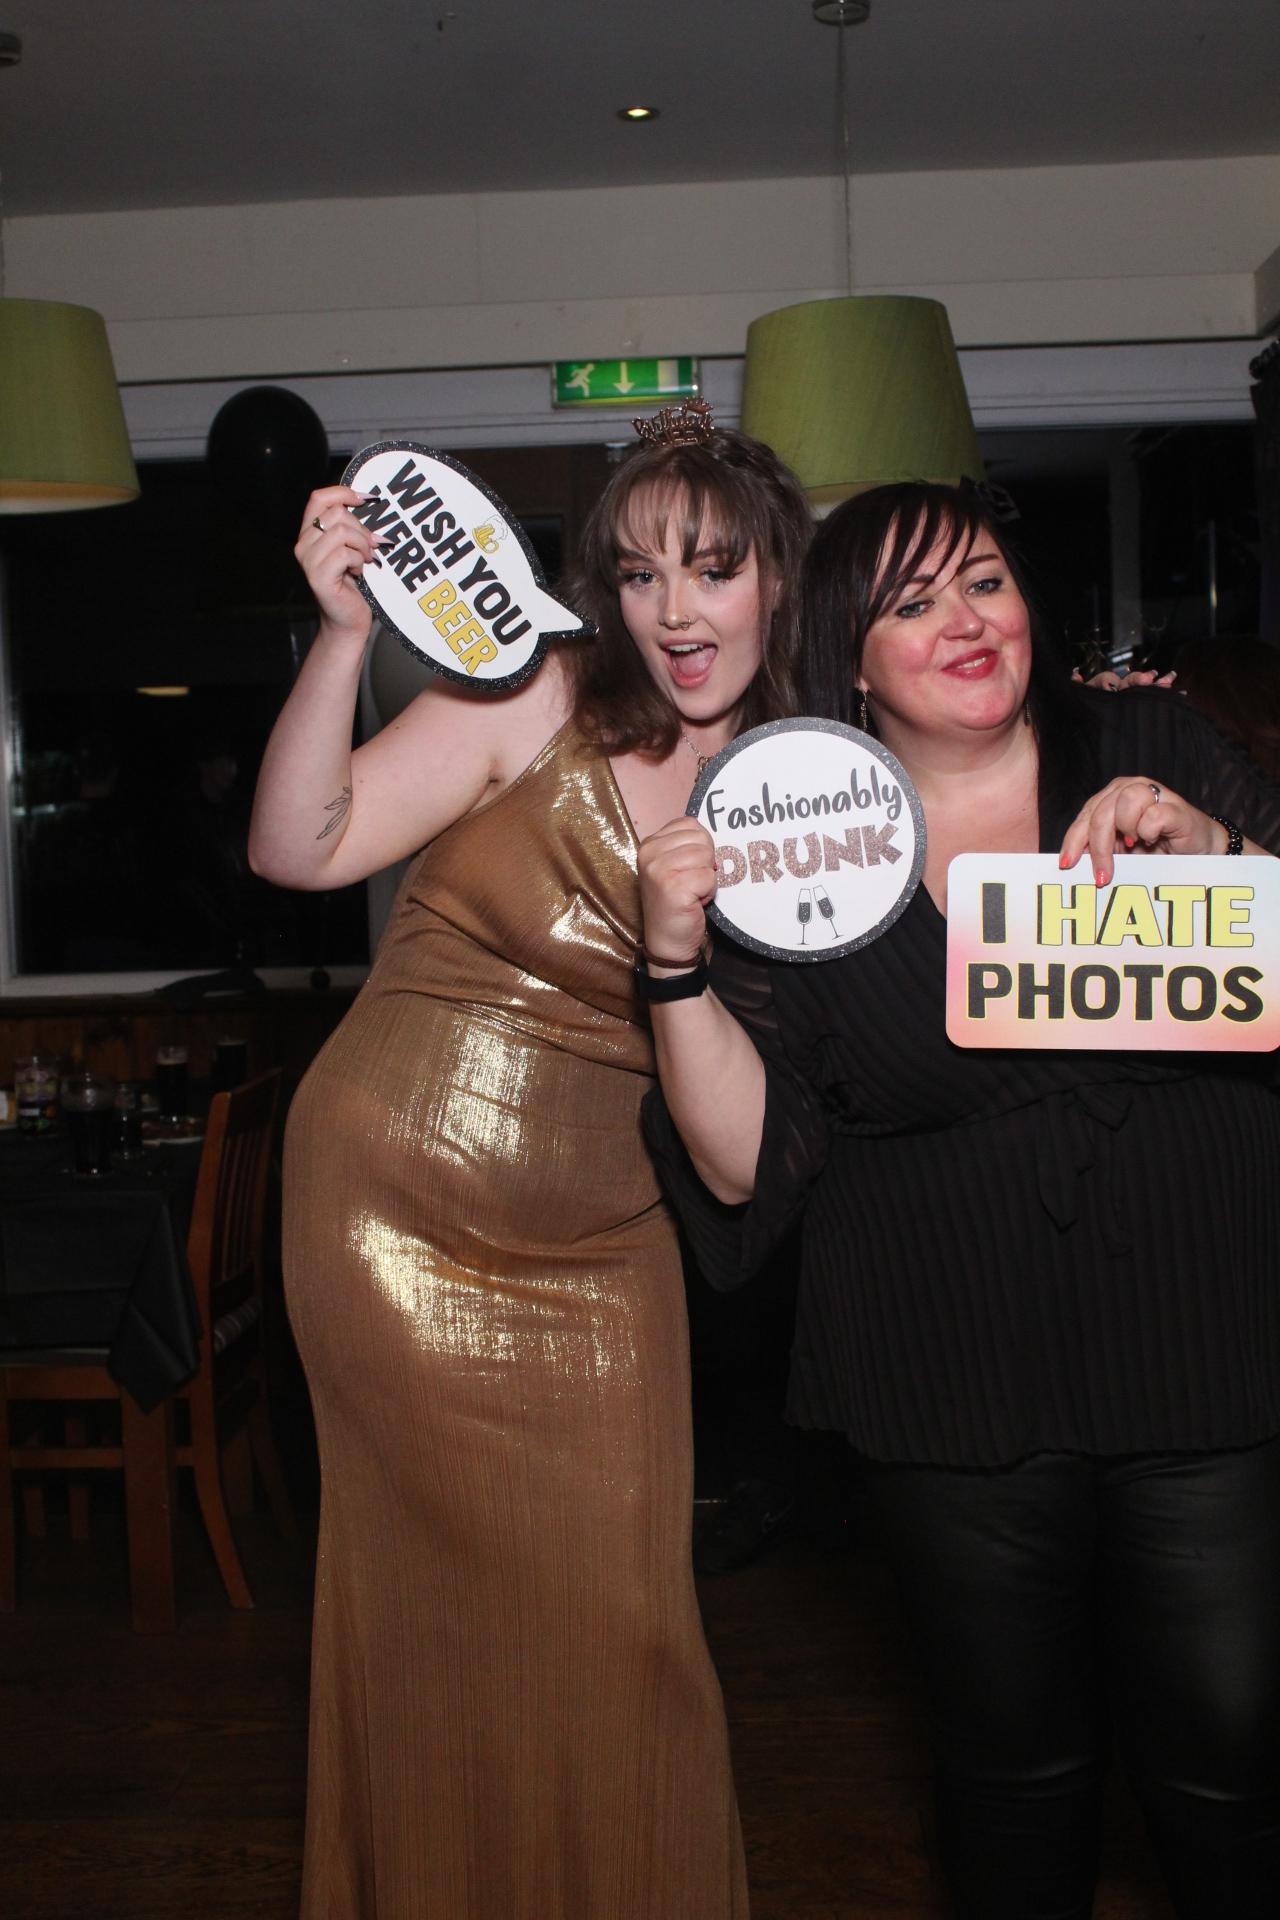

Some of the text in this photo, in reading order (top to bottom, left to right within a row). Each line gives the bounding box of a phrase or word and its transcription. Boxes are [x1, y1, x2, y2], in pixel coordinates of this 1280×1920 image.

[351, 484, 498, 676] WERE BEER
[386, 458, 533, 646] WISH YOU
[706, 764, 902, 833] Fashionably
[714, 822, 904, 889] DRUNK
[981, 882, 1255, 948] I HATE
[966, 962, 1265, 1023] PHOTOS
